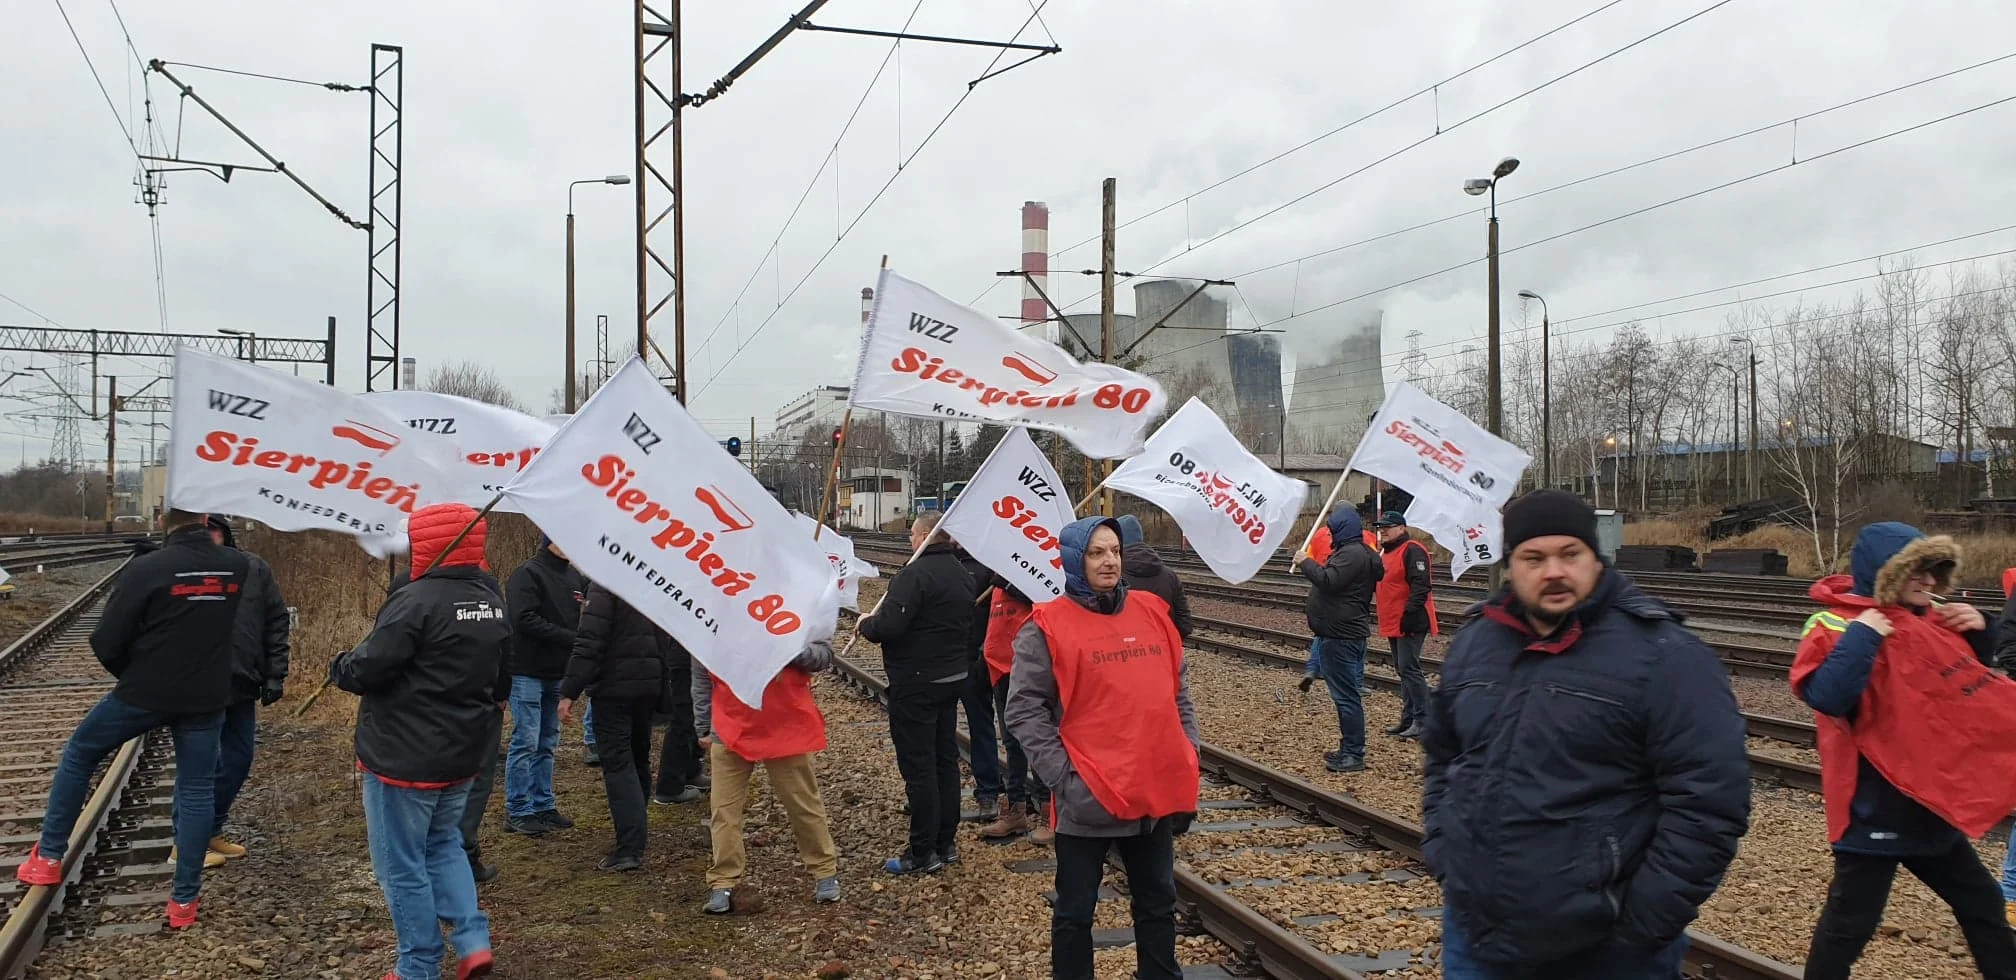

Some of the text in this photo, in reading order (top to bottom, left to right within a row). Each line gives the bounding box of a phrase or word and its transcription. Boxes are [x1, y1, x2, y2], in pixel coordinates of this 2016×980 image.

[908, 312, 959, 344] WZZ
[208, 389, 271, 420] WZZ
[1093, 384, 1151, 413] 80
[622, 411, 662, 456] WZZ
[196, 430, 421, 513] Sierpień
[1017, 465, 1057, 502] WZZ
[258, 487, 395, 537] KONFEDERAC
[581, 455, 802, 636] Sierpień 80
[1474, 543, 1493, 560] 80
